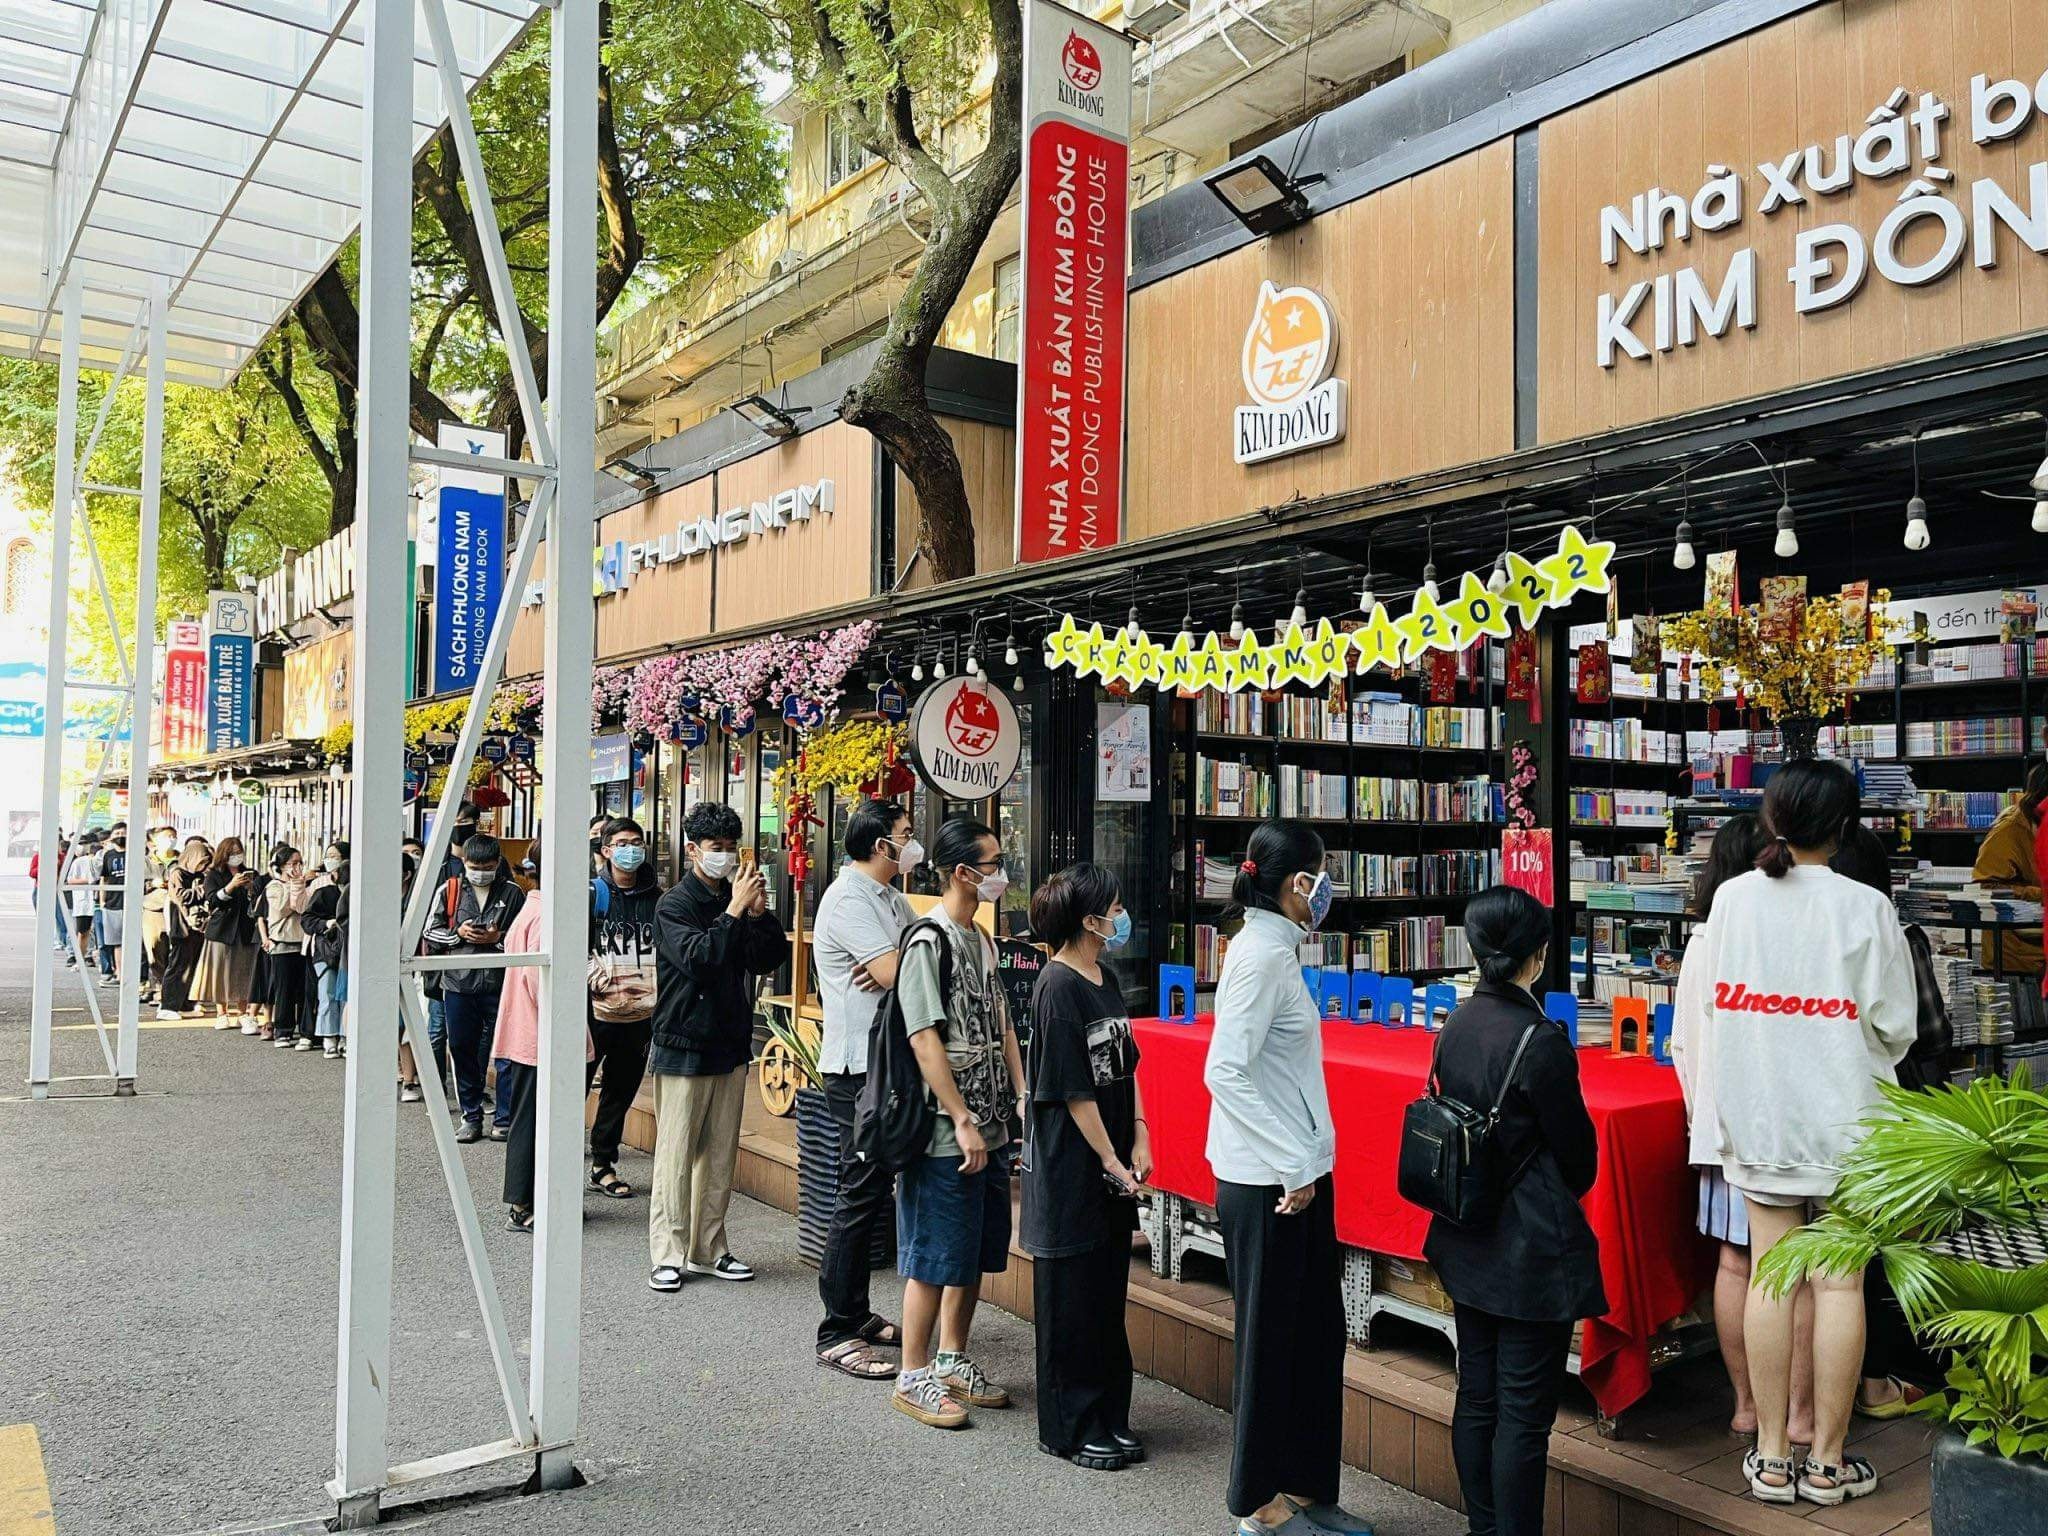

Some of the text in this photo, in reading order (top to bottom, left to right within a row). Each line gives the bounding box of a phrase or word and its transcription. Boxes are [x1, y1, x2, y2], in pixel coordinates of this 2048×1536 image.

[1058, 78, 1077, 107] KIM
[1600, 163, 1743, 266] Nhà
[1757, 85, 1950, 214] xuất
[1597, 247, 1757, 369] KIM
[1044, 143, 1077, 547] NHÀ XUẤT BẢN KIM ĐỒNG
[1079, 154, 1107, 551] KIM DONG PUBLISHING HOUSE
[1239, 411, 1274, 457] KIM
[628, 504, 750, 575] PHƯƠNG
[751, 477, 835, 536] NAM
[294, 523, 355, 621] MINH
[449, 510, 471, 678] SÁCH PHƯƠNG NAM
[473, 527, 489, 666] PHUONG NAM BOOK
[1937, 607, 1977, 629] đến
[234, 644, 243, 673] HOUSE
[1063, 634, 1151, 670] CHÀO
[1174, 649, 1259, 676] NĂM
[932, 746, 960, 781] KIM
[1510, 850, 1544, 873] 10%
[1715, 981, 1860, 1021] Uncover
